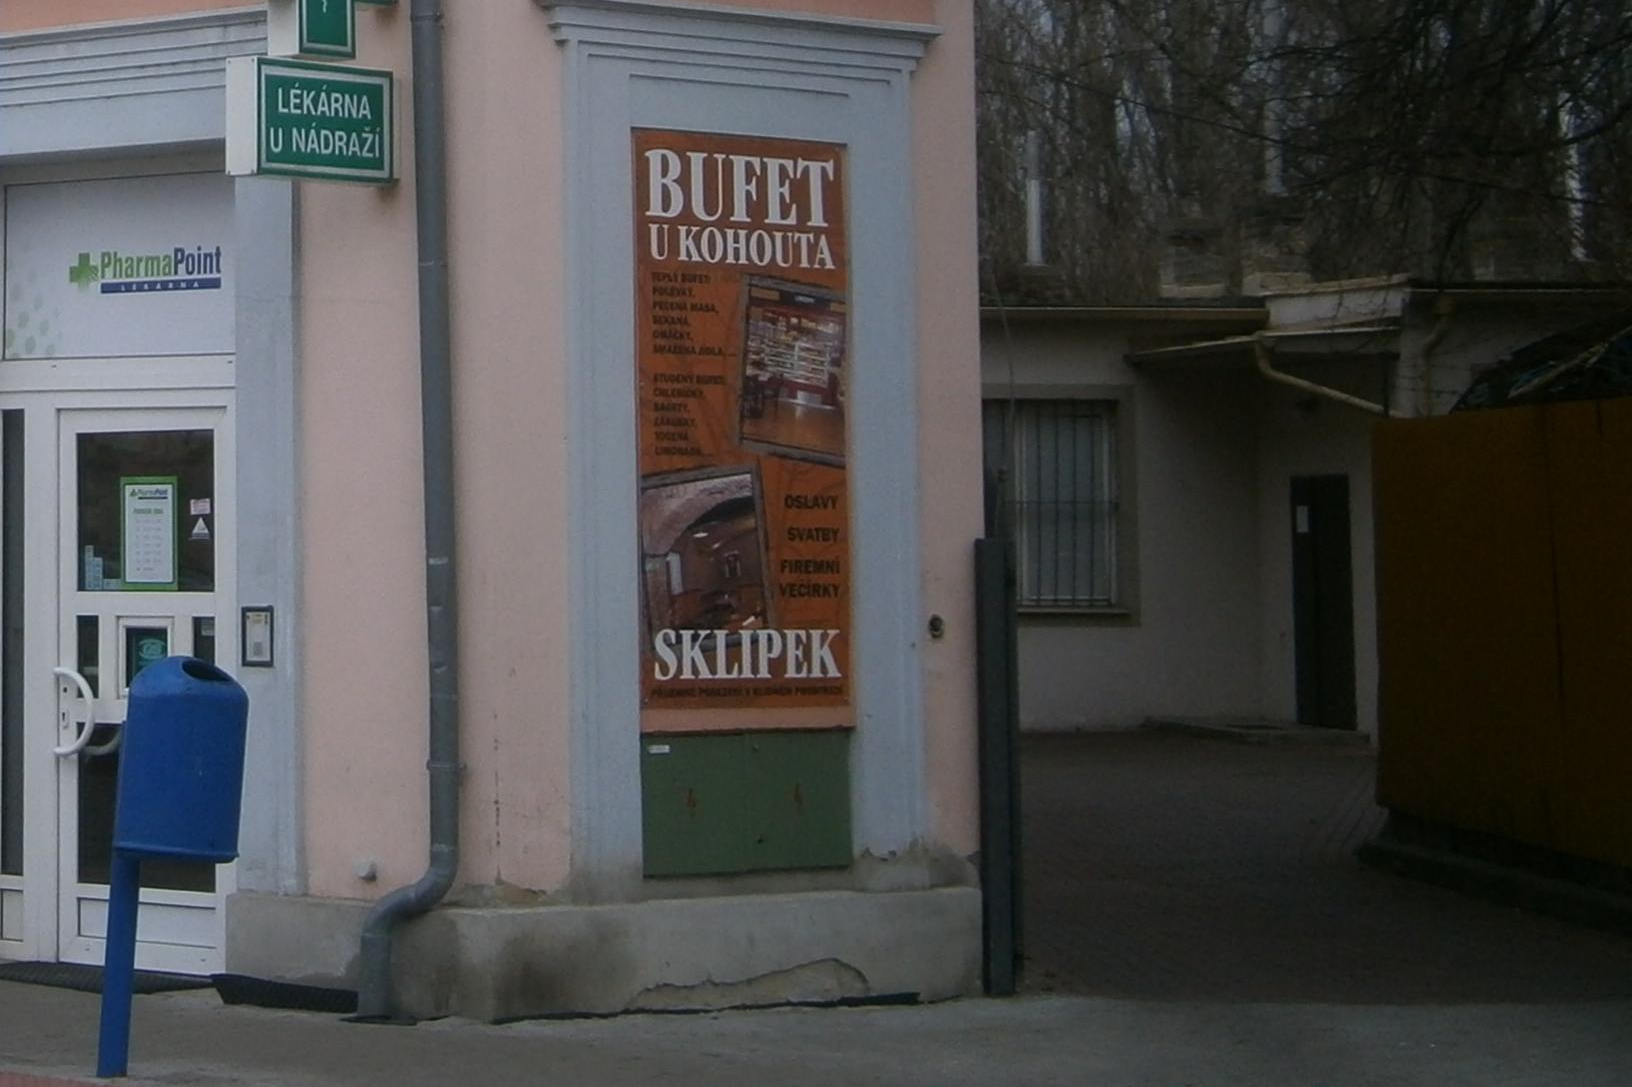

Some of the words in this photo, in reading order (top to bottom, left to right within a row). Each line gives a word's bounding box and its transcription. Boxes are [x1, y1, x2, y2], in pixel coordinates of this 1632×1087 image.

[277, 82, 372, 121] LÉKÁRNA
[270, 125, 283, 153] U
[292, 124, 381, 159] NÁDRAŽÍ
[644, 148, 835, 228] BUFET
[101, 245, 221, 279] PharmaPoint
[648, 223, 669, 261] U
[677, 224, 836, 270] KOHOUTA
[784, 494, 838, 510] OSLAVY
[787, 526, 840, 543] SVATBY
[780, 558, 840, 575] FIREMNÍ
[779, 580, 840, 598] VEČÍRKY
[654, 615, 842, 682] SKLÍPEK
